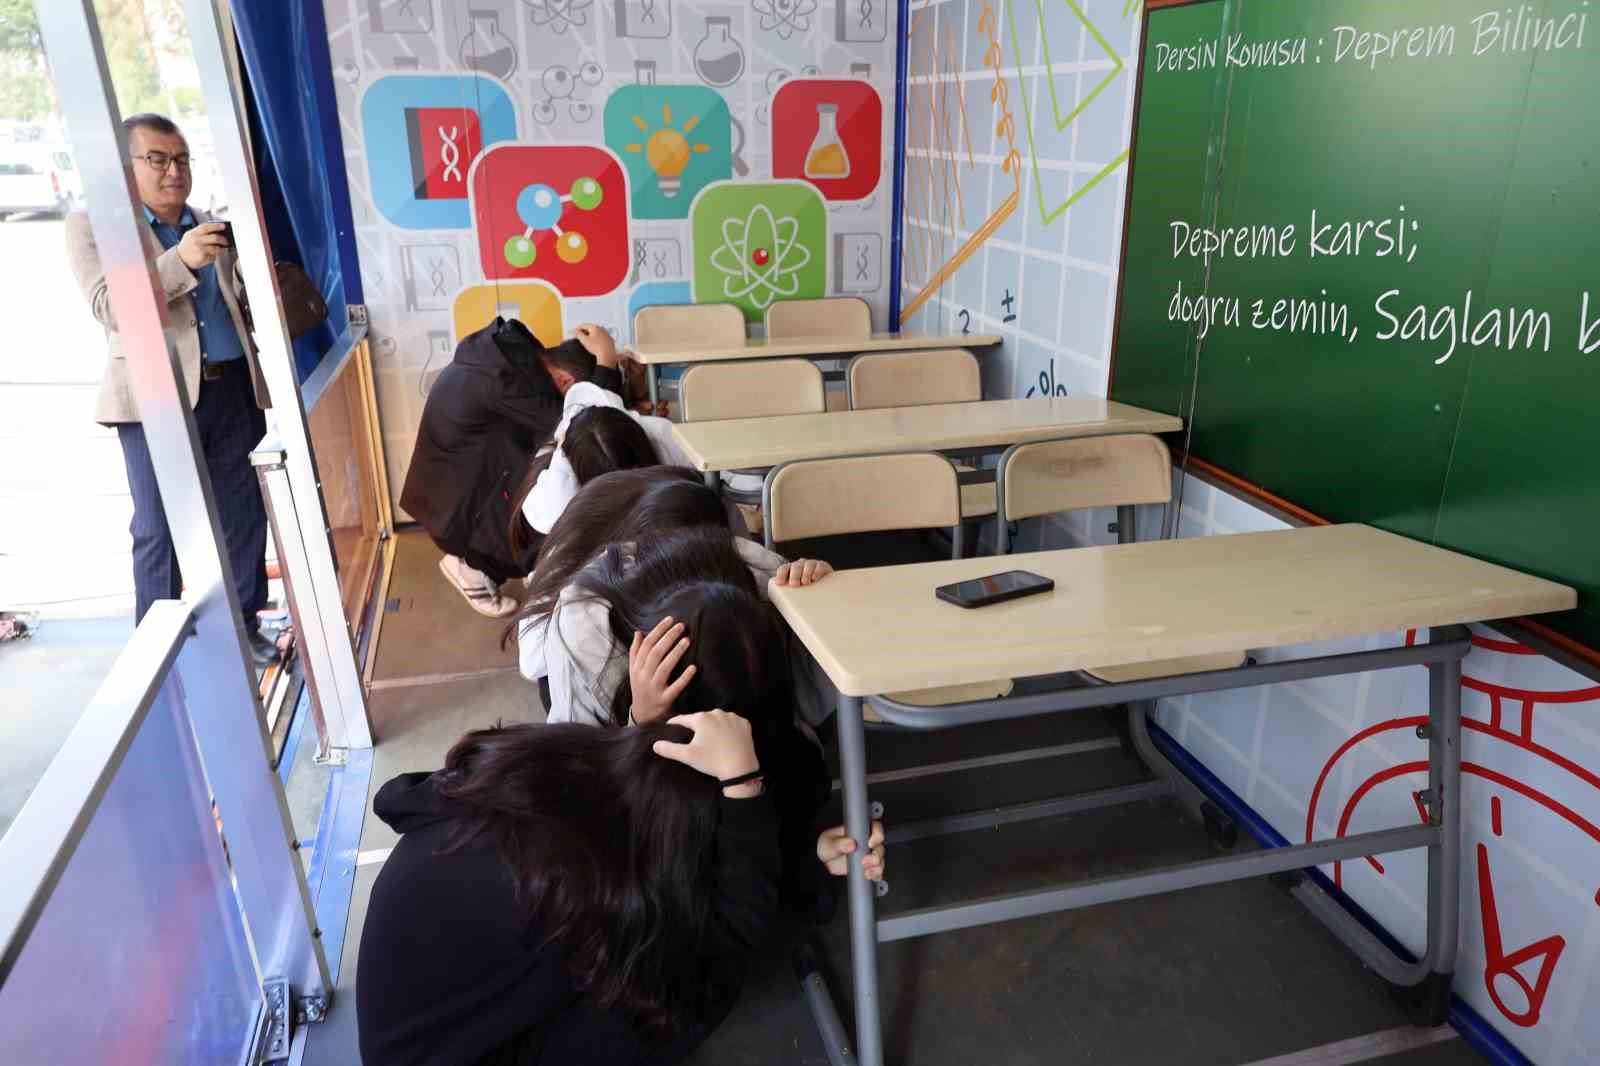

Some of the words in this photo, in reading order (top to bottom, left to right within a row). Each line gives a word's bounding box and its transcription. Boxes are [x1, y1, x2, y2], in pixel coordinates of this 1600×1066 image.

[1225, 31, 1307, 67] Konusu
[1333, 24, 1456, 69] Deprem
[1471, 0, 1589, 56] Bilinci
[1170, 220, 1296, 266] Depreme
[1309, 205, 1419, 262] karsi;
[1168, 280, 1239, 339] dogru
[1251, 289, 1358, 343] zemin,
[1374, 289, 1551, 365] Saglam
